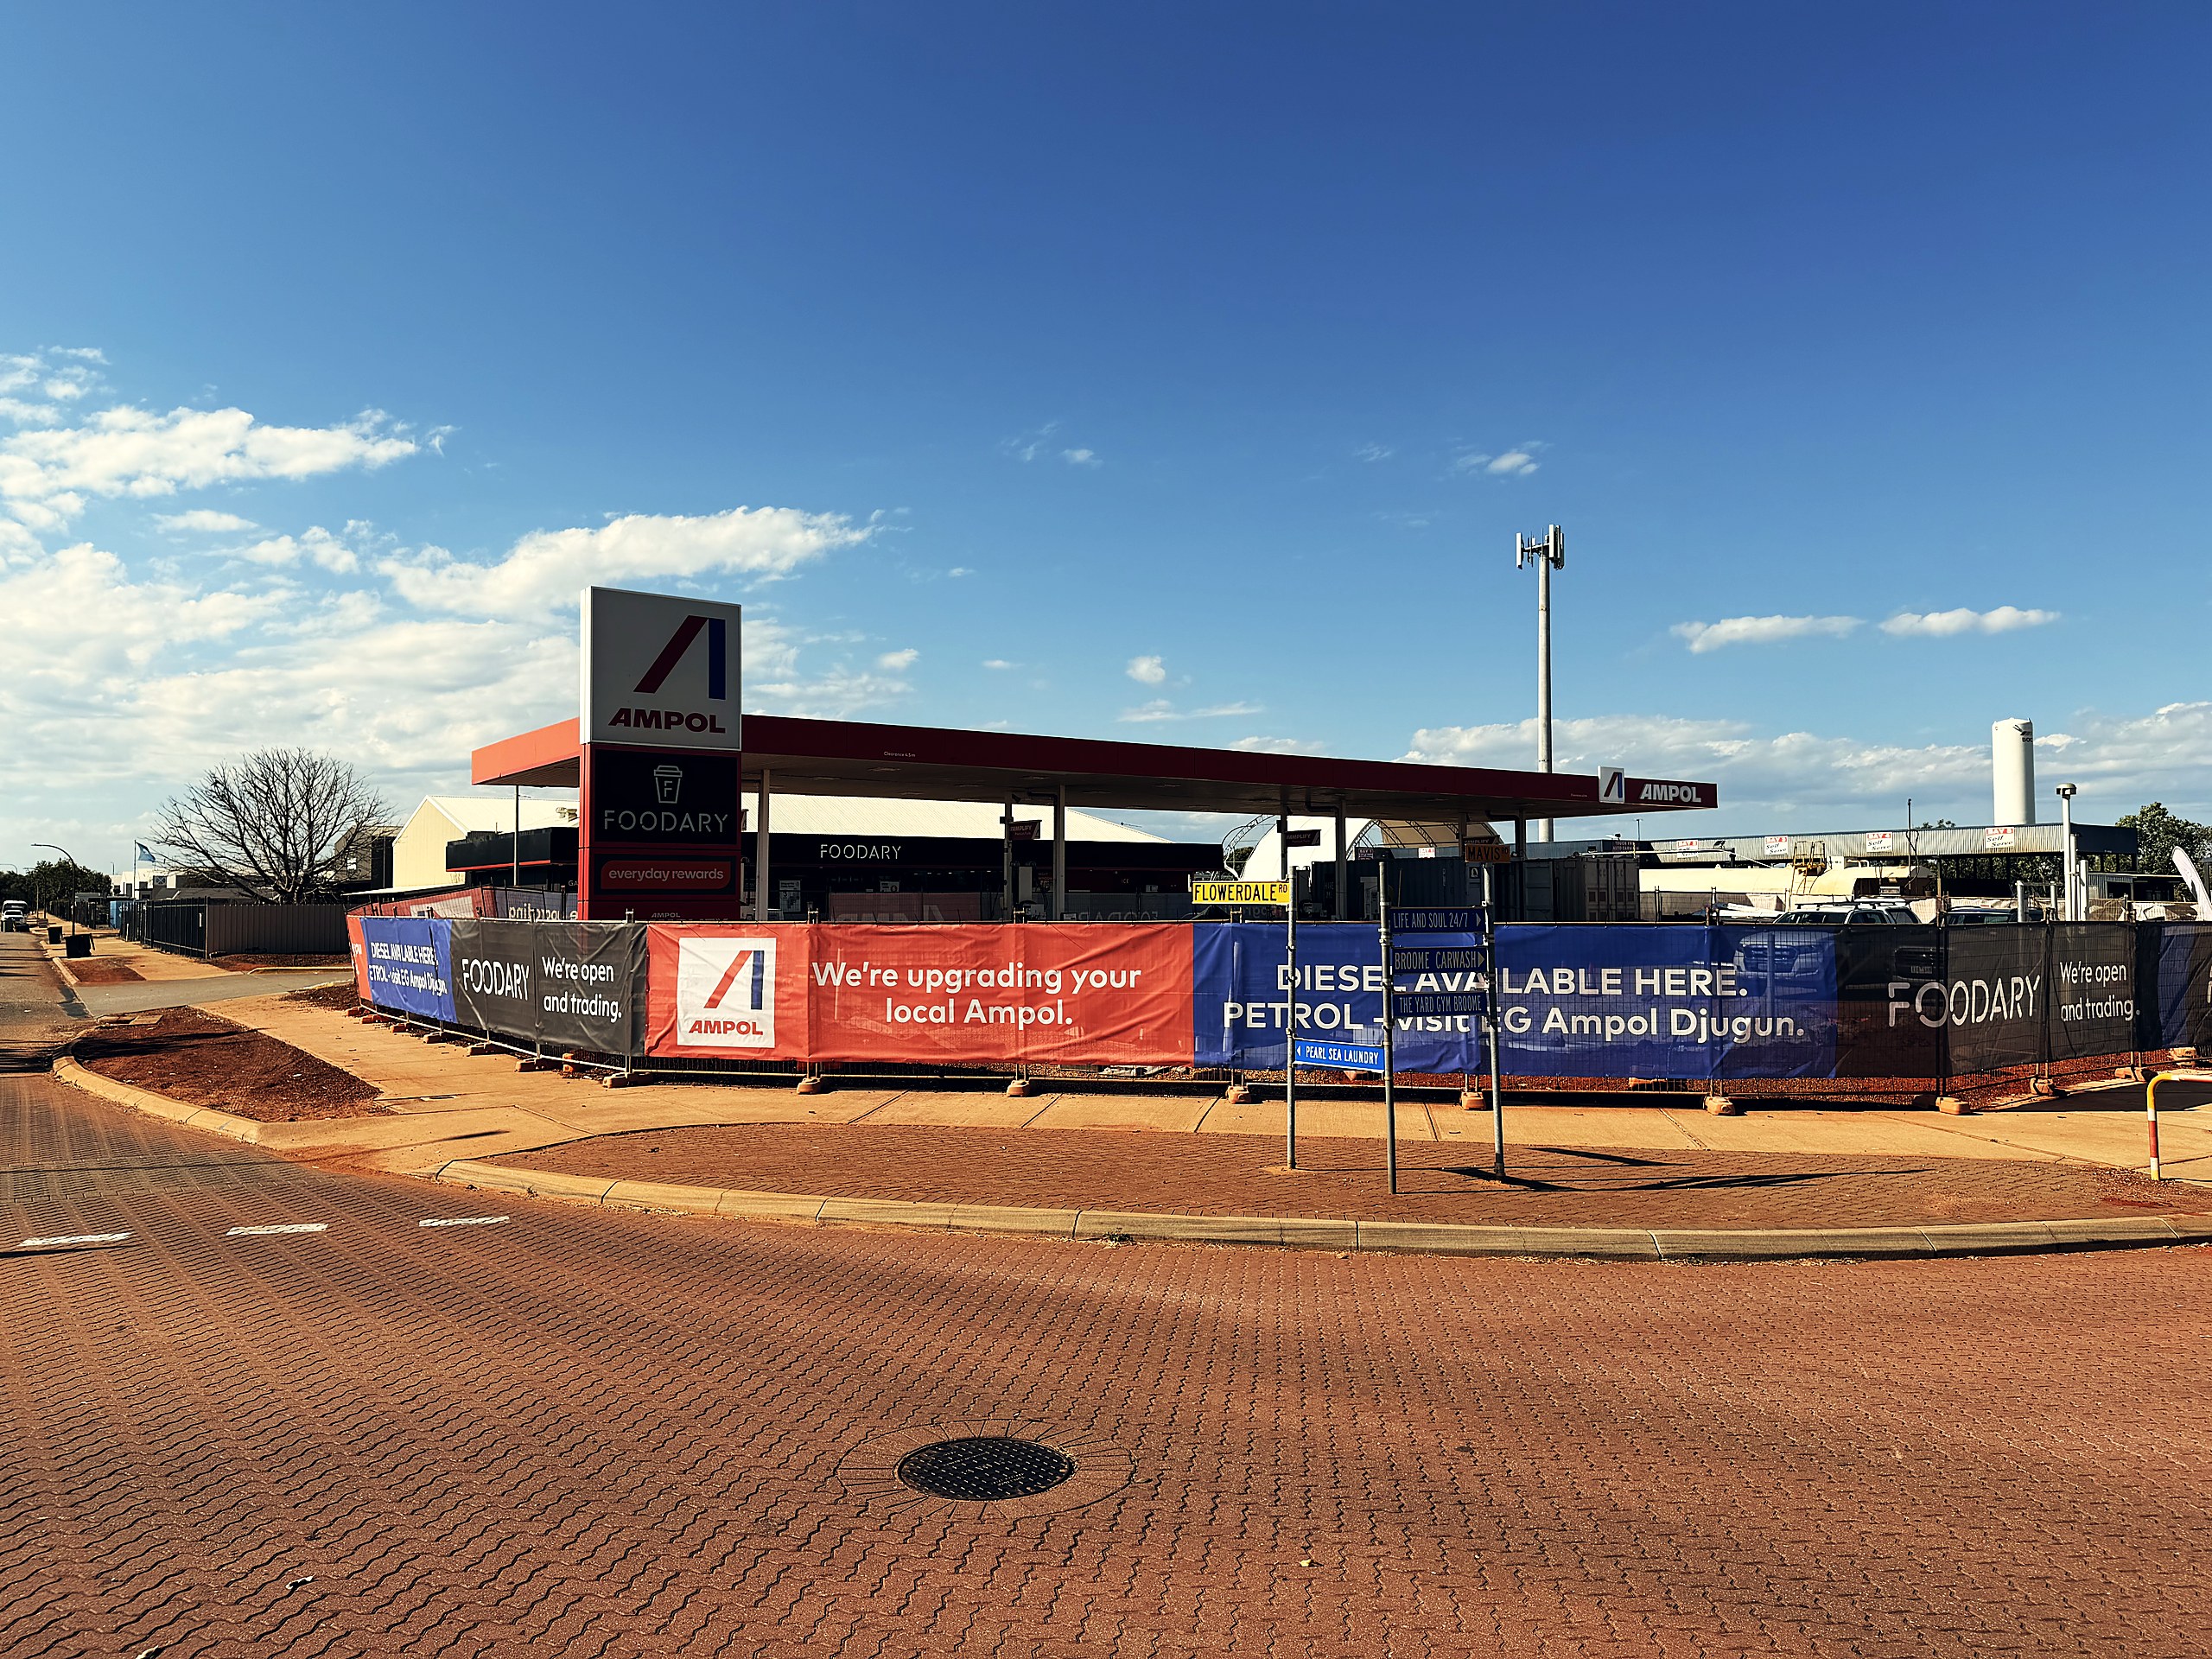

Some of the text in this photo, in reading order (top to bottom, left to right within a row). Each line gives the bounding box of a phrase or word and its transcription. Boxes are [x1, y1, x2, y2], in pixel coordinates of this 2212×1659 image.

[608, 707, 726, 734] AMPOL
[1639, 784, 1702, 803] AMPOL
[604, 810, 728, 833] FOODARY
[819, 844, 901, 860] FOODARY
[1468, 846, 1509, 861] MAVIS RD
[608, 868, 724, 882] everyday rewards
[1195, 884, 1278, 901] FLOWERDALE
[1393, 912, 1468, 928] LIFE AND SOUL 24/7
[371, 942, 391, 960] DIESEL
[391, 943, 419, 963] AVALABLE
[1395, 951, 1477, 969] BROOME CARWASH
[368, 964, 389, 982] ETROL
[462, 958, 531, 1001] FOODARY
[542, 957, 614, 986] We're open
[812, 962, 1142, 997] We're upgrading your
[2060, 960, 2127, 987] We're open
[1636, 969, 1748, 997] HERE.
[543, 992, 622, 1024] and trading.
[1399, 995, 1482, 1014] THE YARD GYM BROOME
[1888, 975, 2041, 1027] FOODARY
[2061, 995, 2141, 1022] and trading.
[886, 997, 1073, 1031] local Ampol.
[1224, 1002, 1364, 1029] PETROL
[1542, 1007, 1658, 1042] Ampol
[1671, 1007, 1805, 1045] Djugun.
[688, 1020, 763, 1036] AMPOL
[1306, 1045, 1379, 1065] PEARL SEA LAUNDRY
